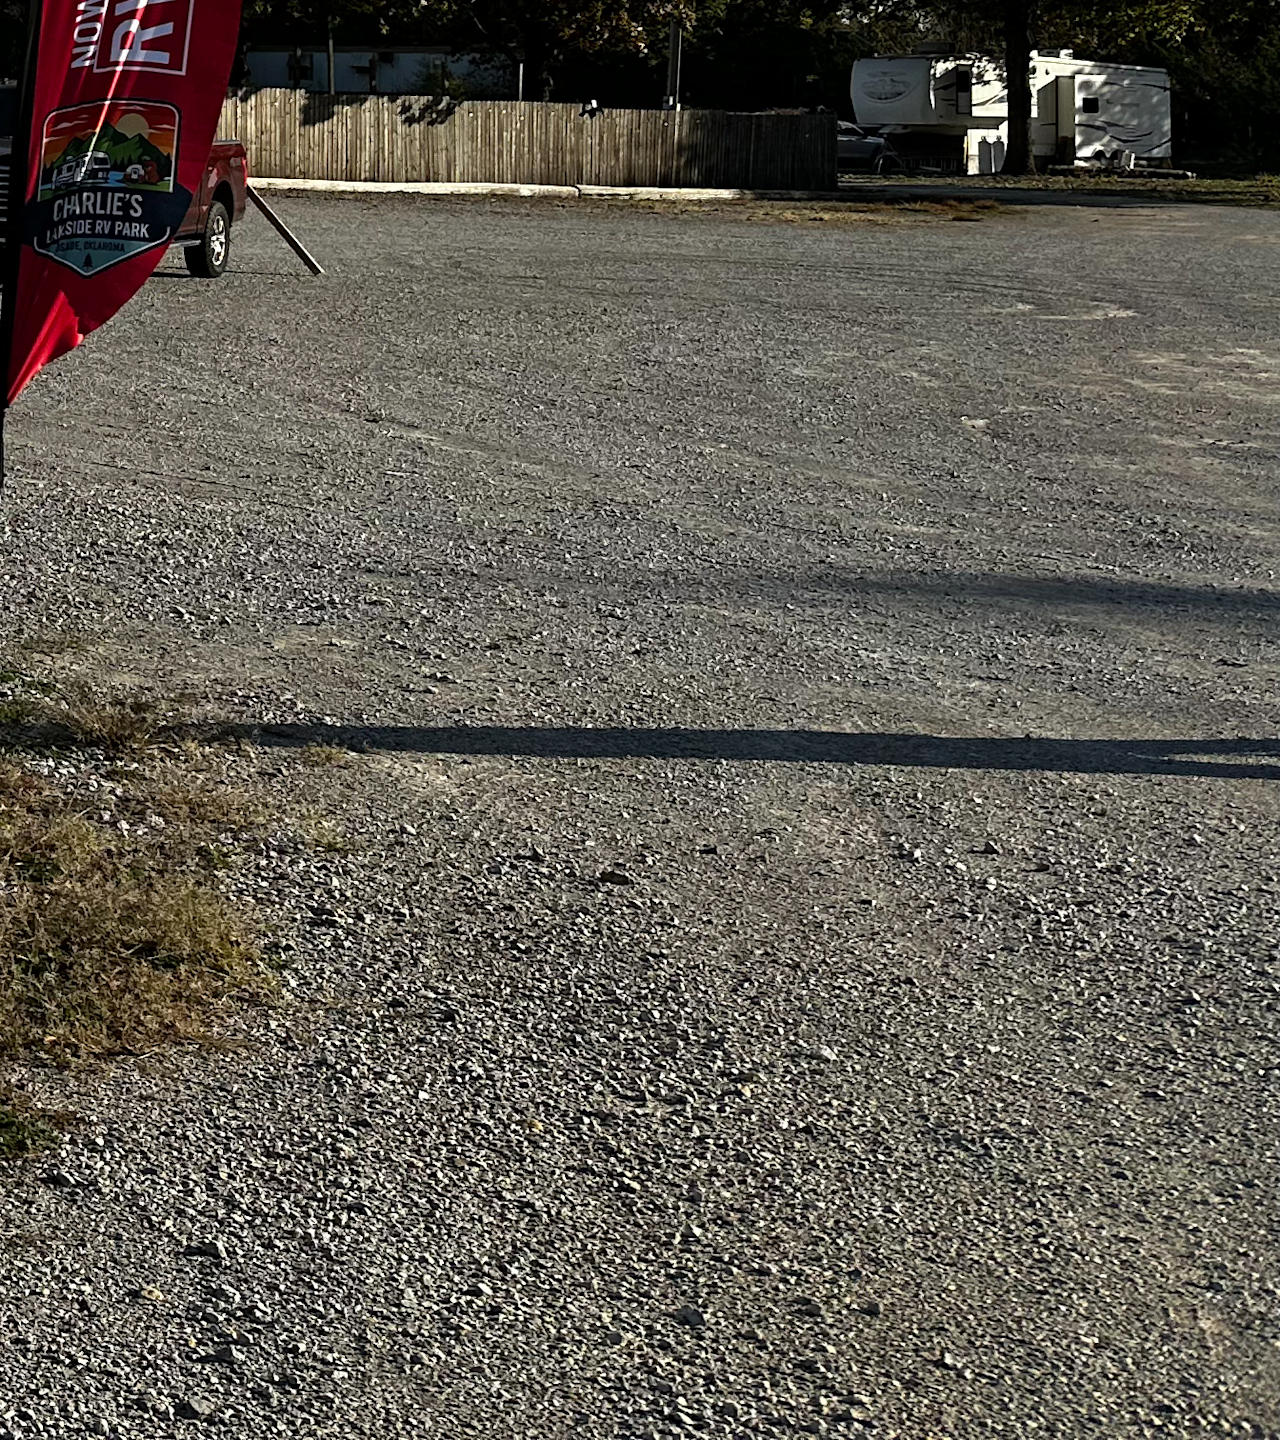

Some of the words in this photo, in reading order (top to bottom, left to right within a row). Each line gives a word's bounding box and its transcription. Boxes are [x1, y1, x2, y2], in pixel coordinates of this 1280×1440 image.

[54, 192, 143, 221] CHARLIE'S
[46, 220, 93, 244] LAKSIDE
[95, 220, 111, 235] RV
[115, 222, 149, 238] PARK
